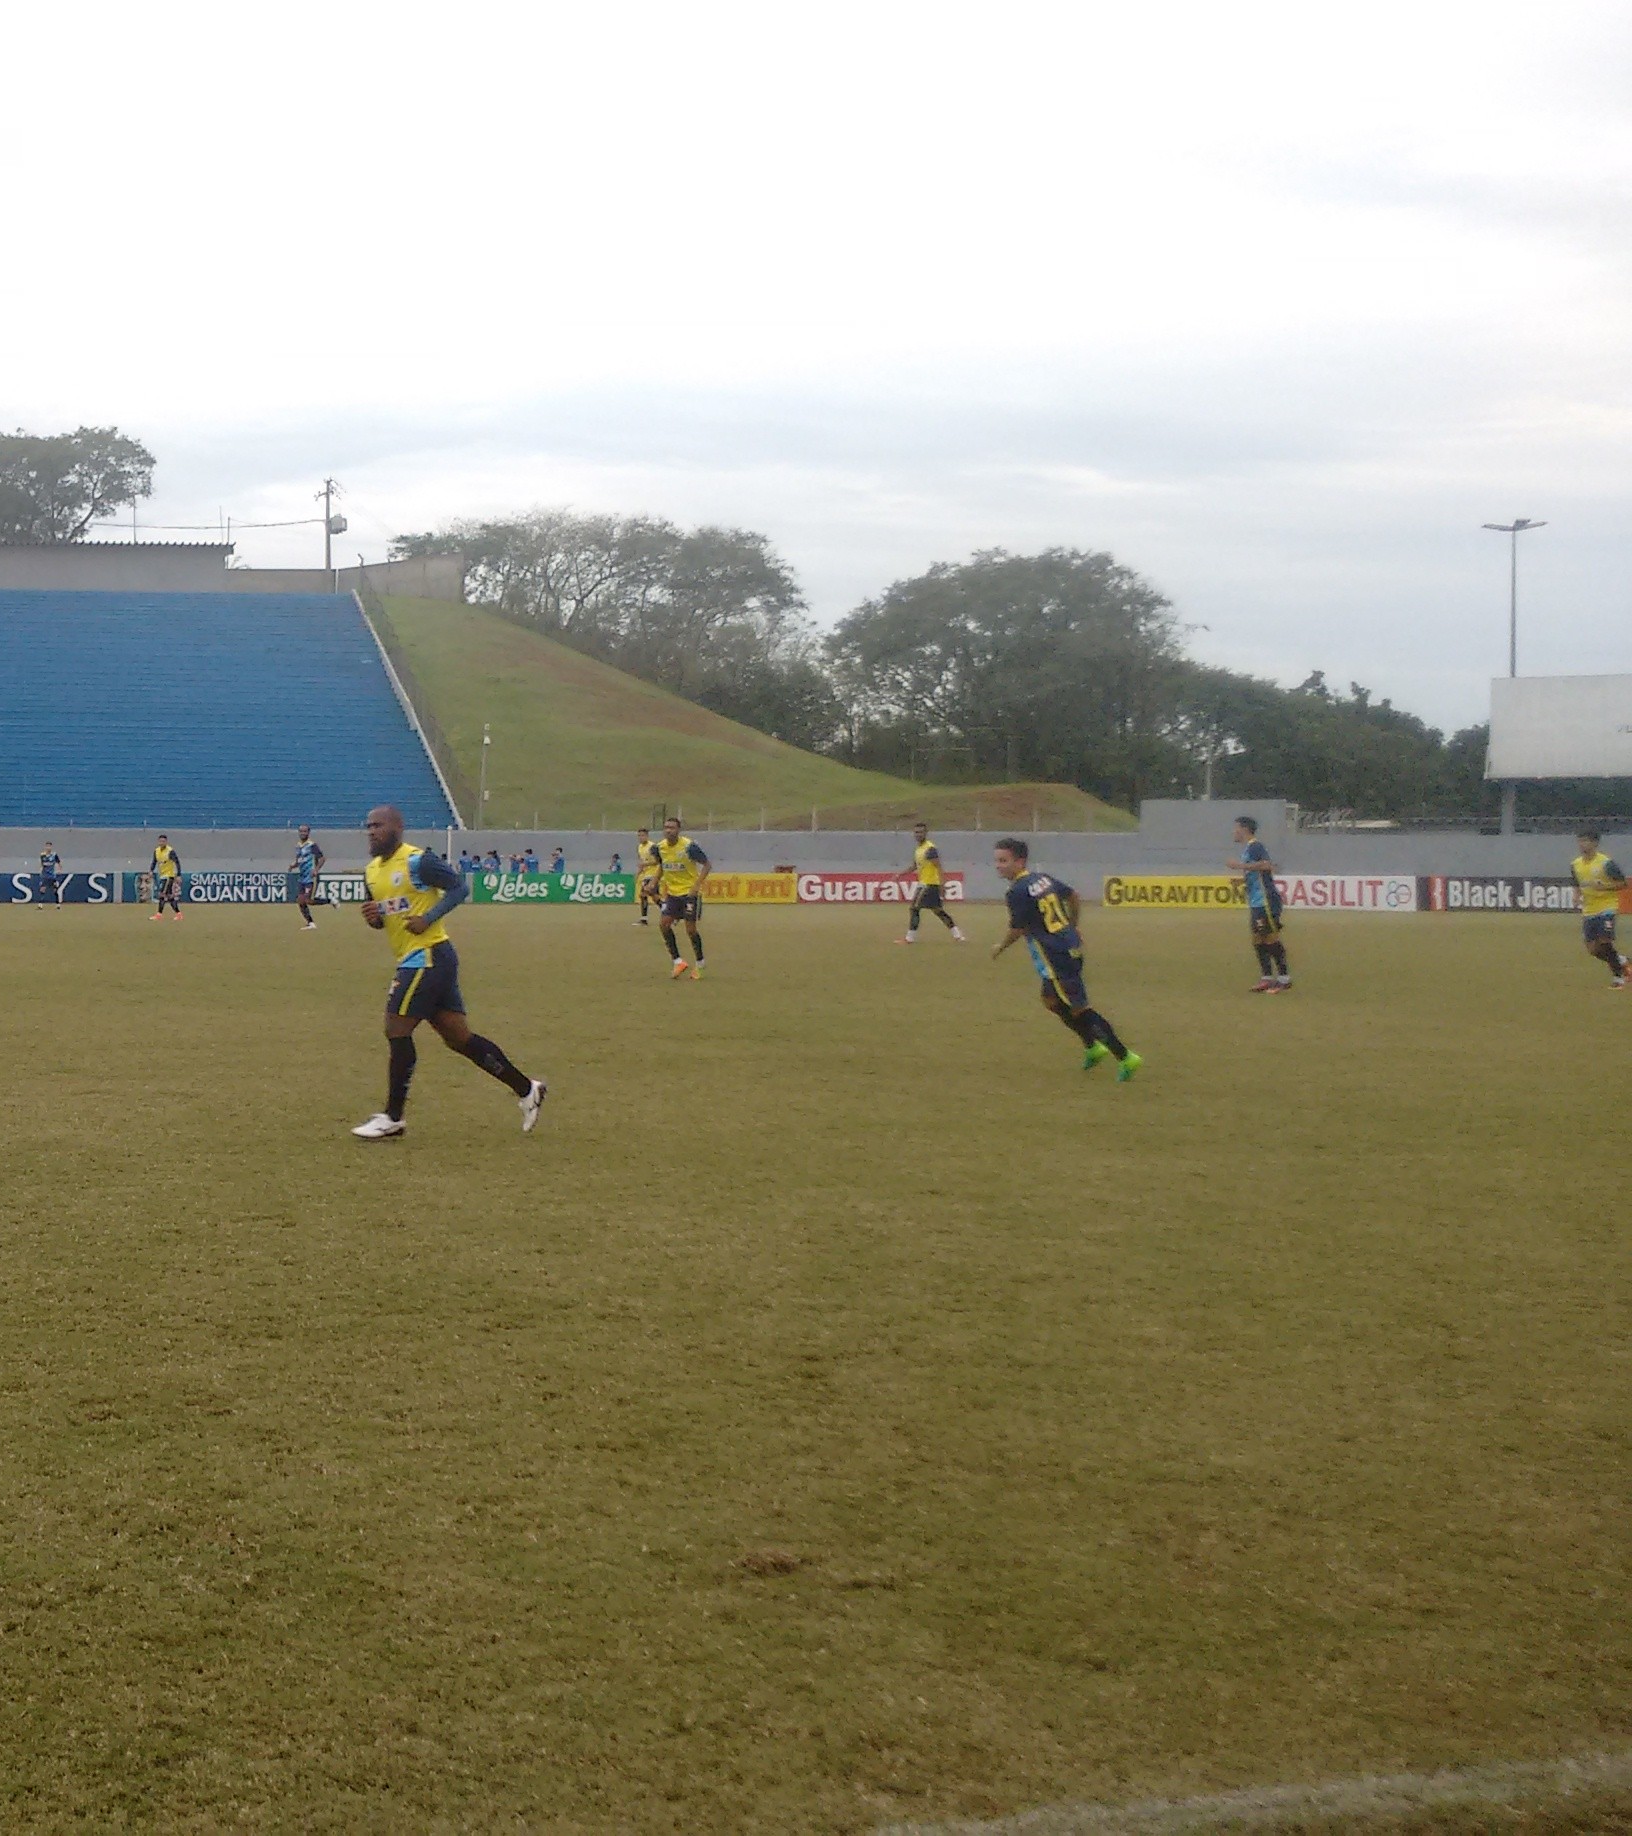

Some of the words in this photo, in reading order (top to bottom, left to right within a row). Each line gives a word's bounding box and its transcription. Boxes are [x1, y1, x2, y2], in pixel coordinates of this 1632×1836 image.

[190, 873, 287, 886] SMARTPHONES
[492, 874, 548, 902] Lebes
[569, 874, 625, 902] Lebes
[798, 874, 964, 901] Guarava
[189, 886, 287, 902] QUANTUM
[1449, 880, 1511, 907] Black
[1518, 880, 1581, 908] Jean
